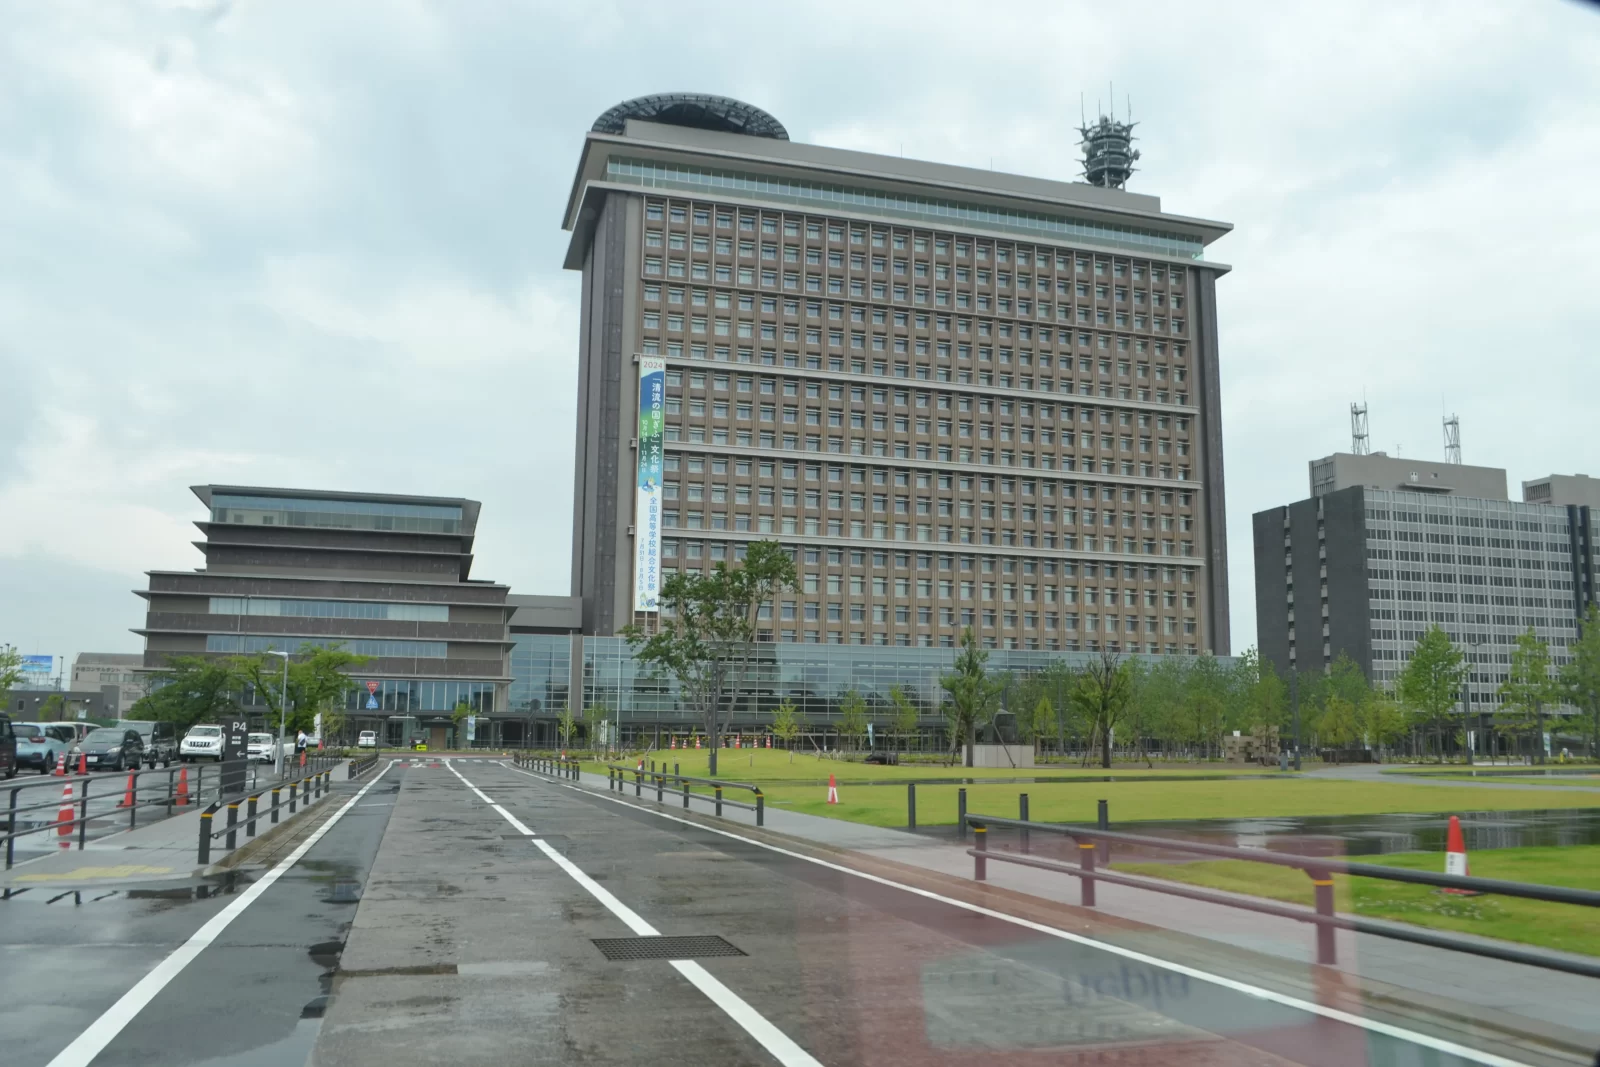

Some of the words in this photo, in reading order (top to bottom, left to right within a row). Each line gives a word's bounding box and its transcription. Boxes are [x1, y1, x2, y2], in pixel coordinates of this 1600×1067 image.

[644, 361, 663, 369] 2024
[650, 378, 662, 473] 「清流の国ぎふ」文化祭
[647, 496, 658, 591] 全国高等学校総合文化祭
[232, 721, 247, 732] P4
